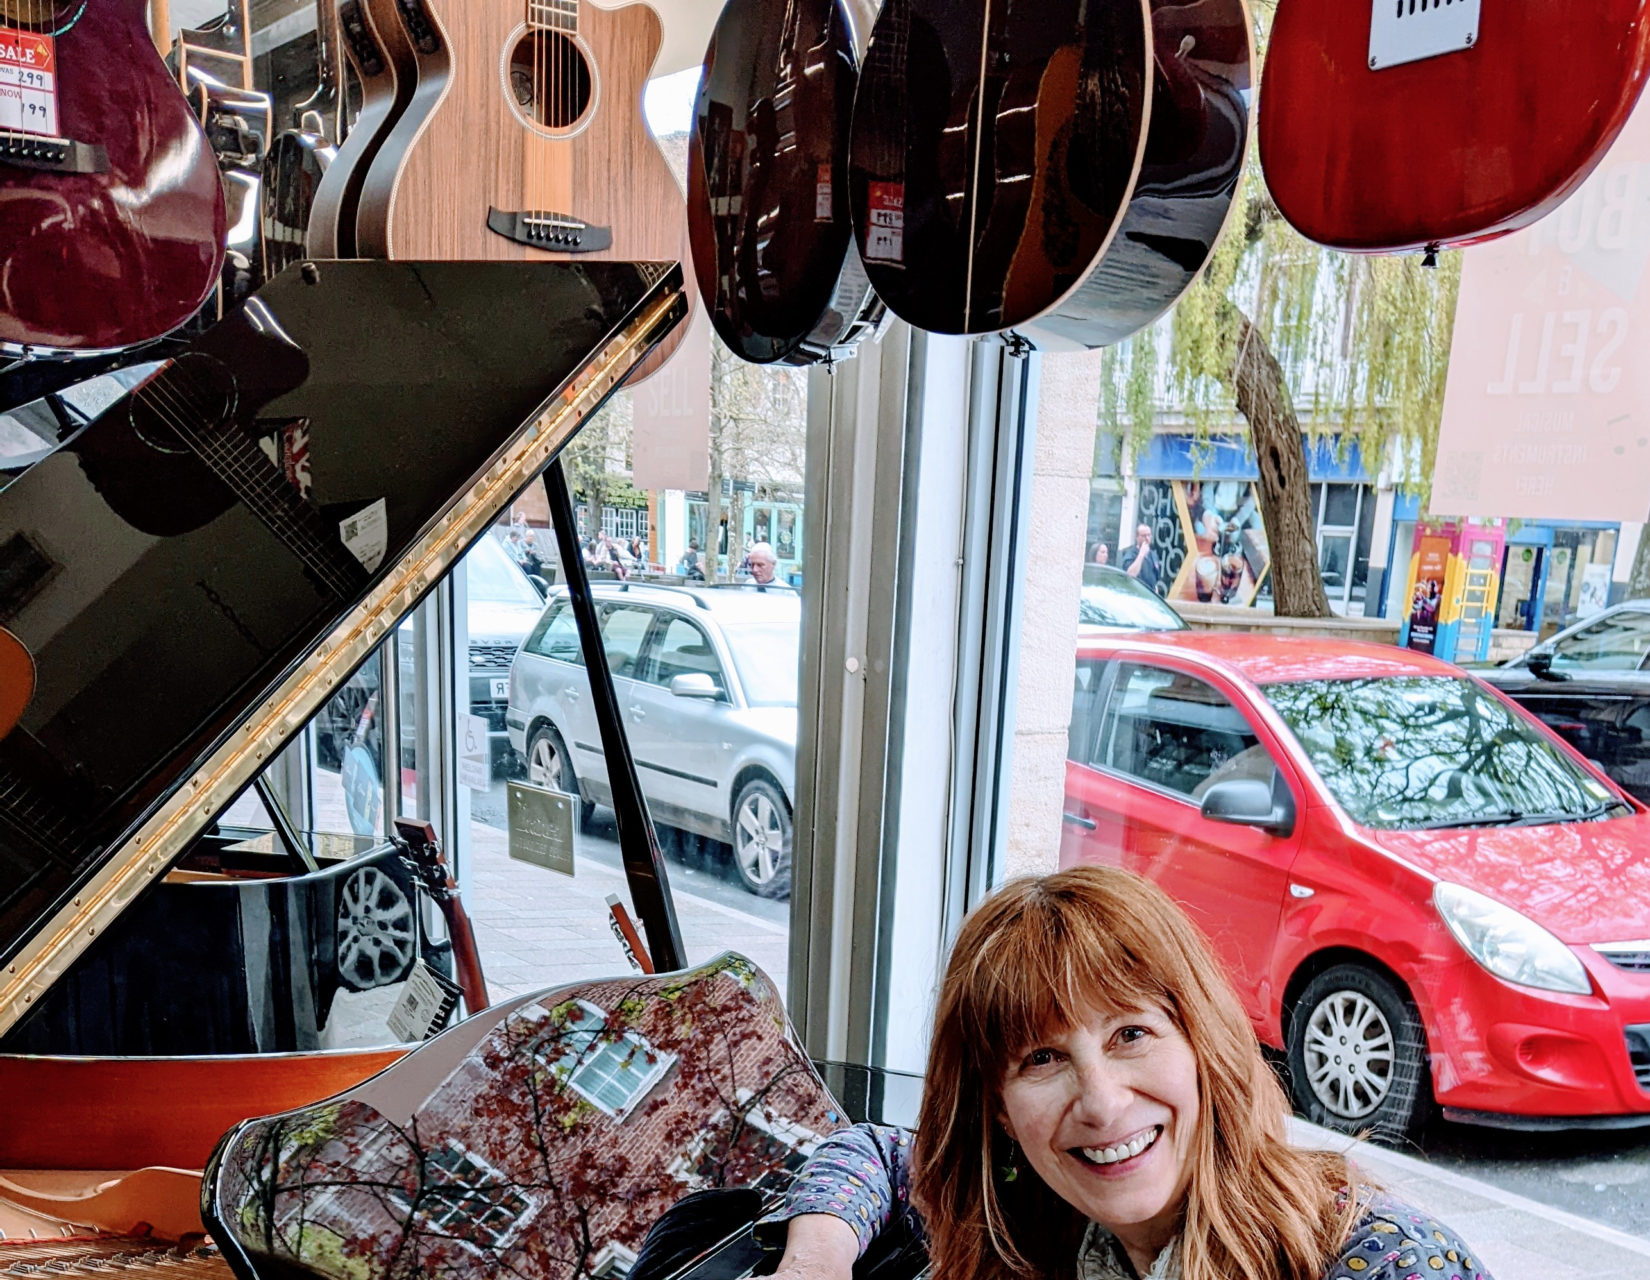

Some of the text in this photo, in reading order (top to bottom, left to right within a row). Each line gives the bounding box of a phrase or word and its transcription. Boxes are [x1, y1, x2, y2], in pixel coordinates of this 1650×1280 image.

[0, 44, 35, 63] SALE
[0, 88, 21, 99] NOW
[21, 103, 46, 118] 199
[648, 366, 694, 417] SELL
